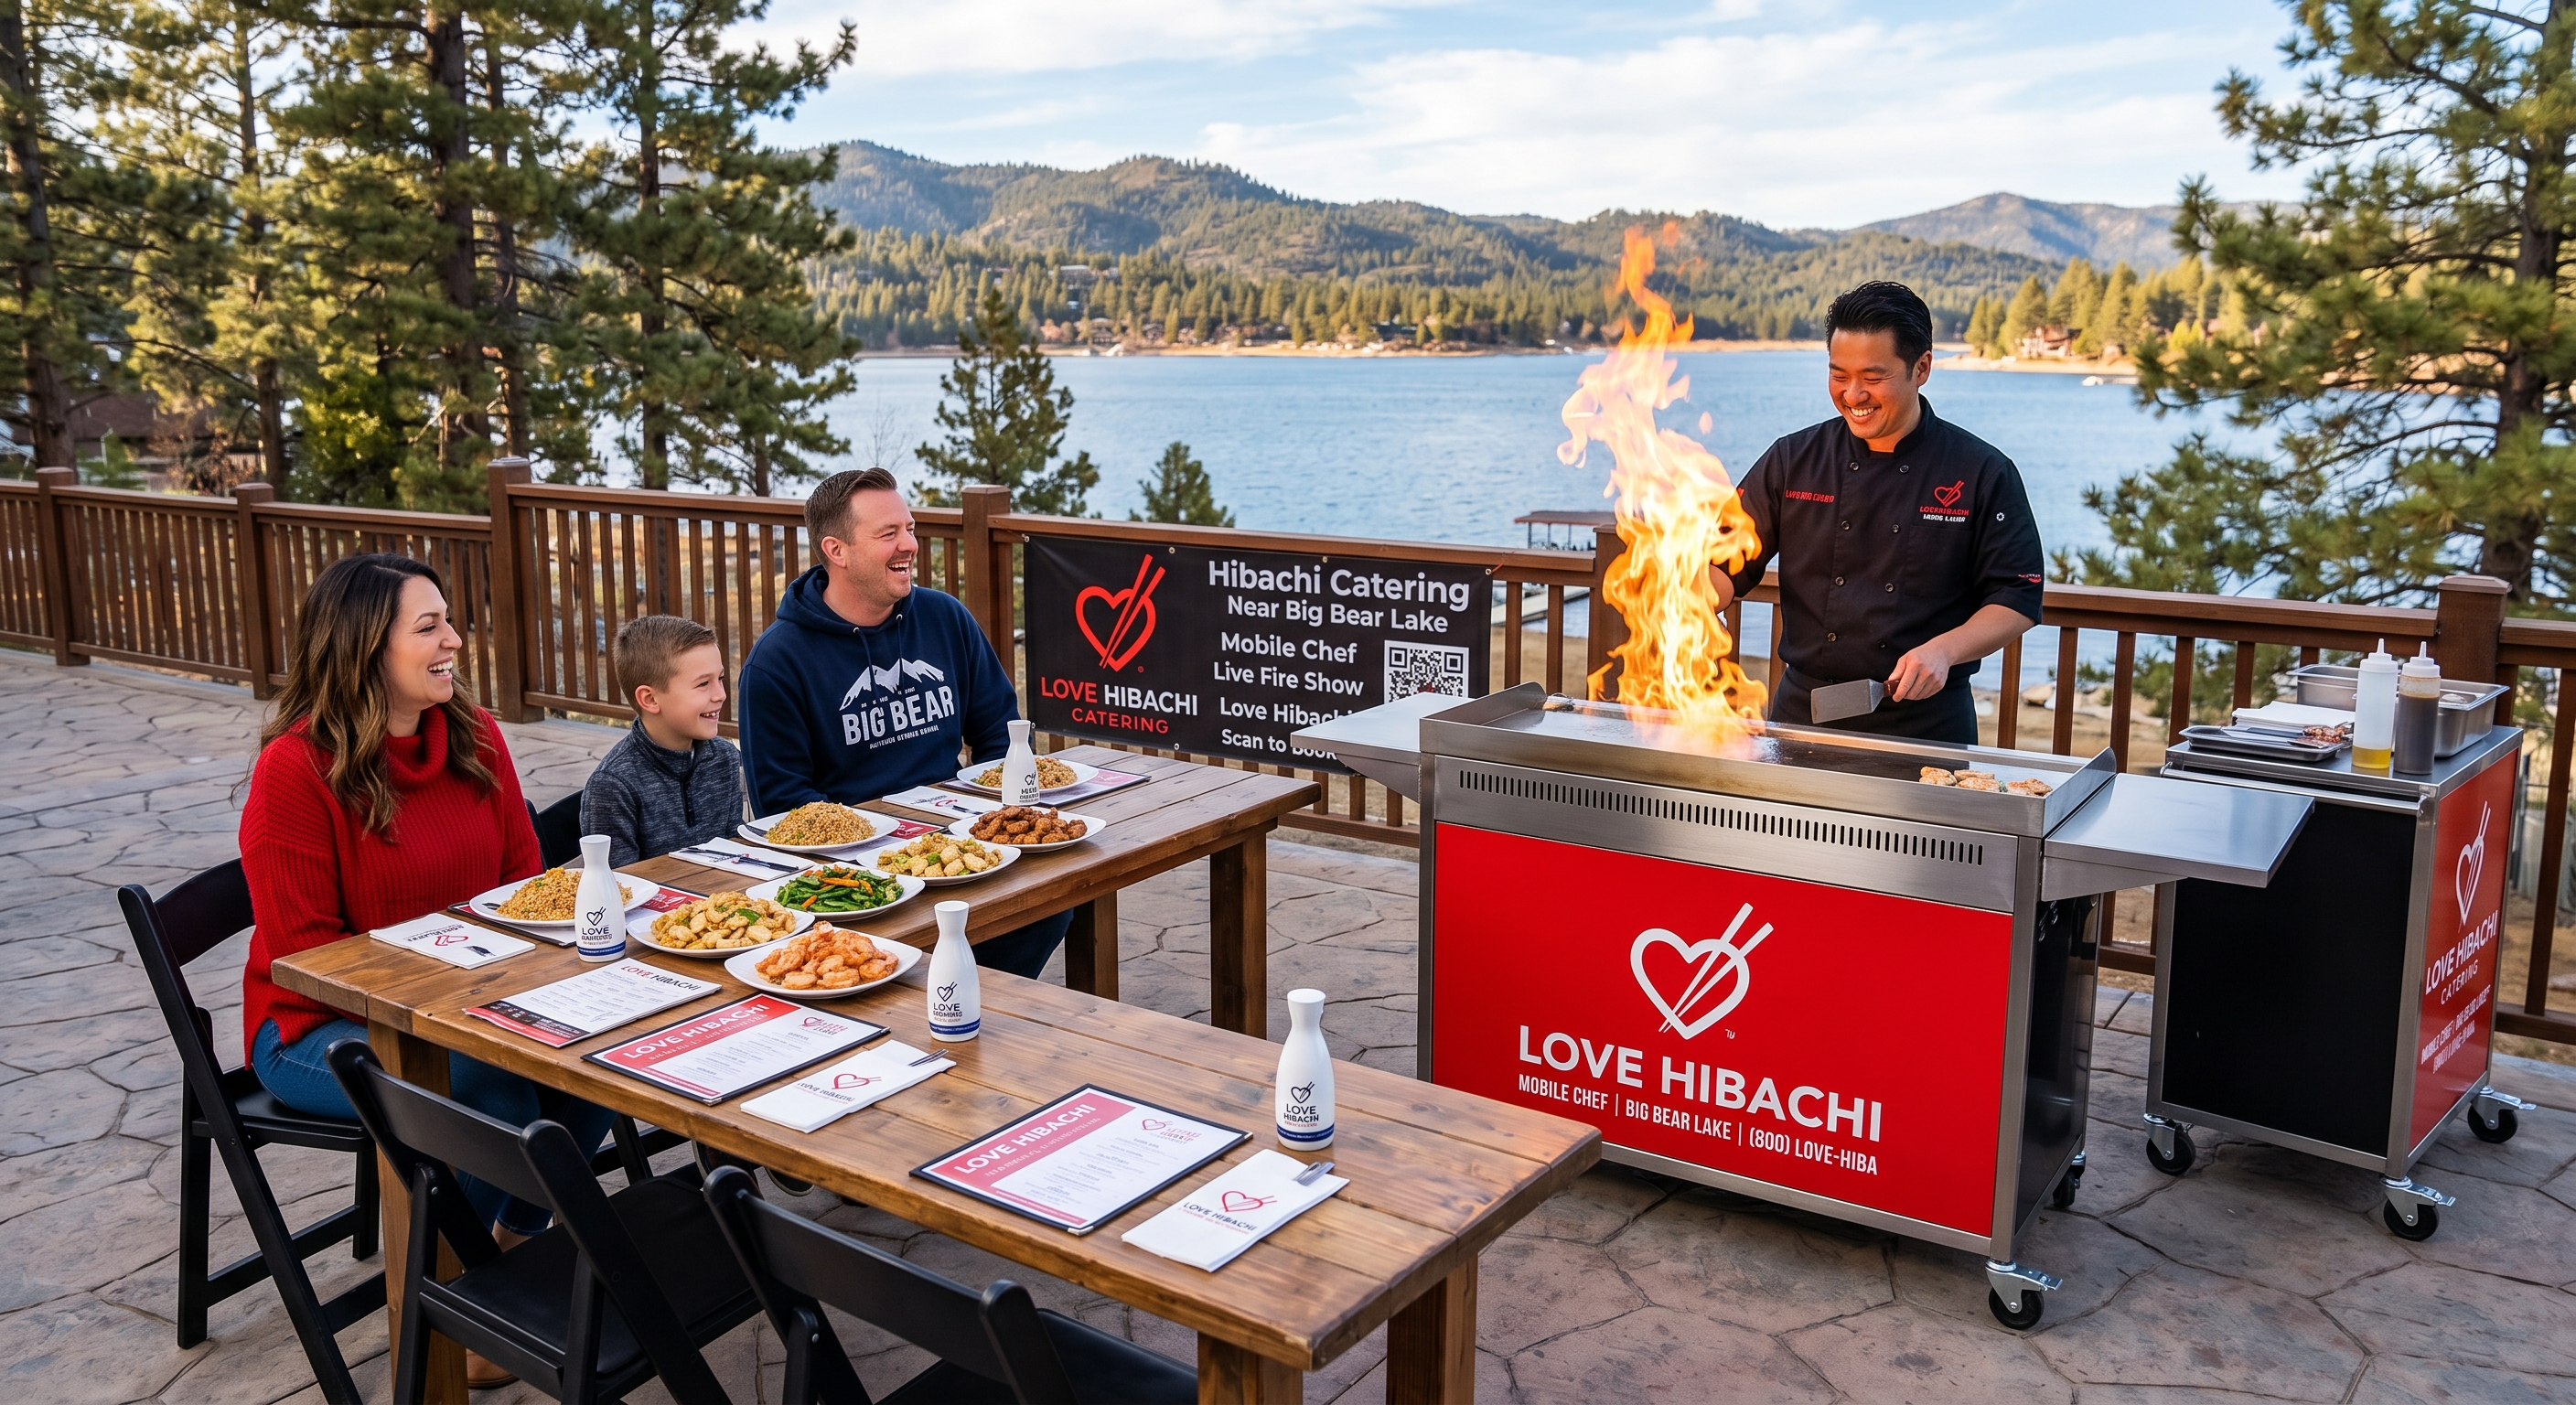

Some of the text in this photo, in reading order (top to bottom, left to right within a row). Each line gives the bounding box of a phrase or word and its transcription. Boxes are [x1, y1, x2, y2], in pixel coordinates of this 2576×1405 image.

[1208, 560, 1470, 612] Hibachi Catering
[1227, 595, 1449, 633] Near Big Bear Lake
[1221, 631, 1358, 664] Mobile Chef
[1041, 676, 1198, 716] LOVE HIBACHI
[1213, 661, 1364, 697] Live Fire Show
[842, 707, 886, 745] BIG
[889, 685, 955, 732] BEAR
[1071, 707, 1169, 735] CATERING
[1220, 696, 1353, 726] Love Hibac
[1221, 728, 1263, 750] Scan
[1268, 735, 1287, 753] to
[582, 927, 610, 936] LOVE
[2425, 909, 2498, 996] LOVE HIBACHI
[2441, 959, 2479, 1005] CATERING
[933, 1003, 961, 1012] LOVE
[623, 1035, 682, 1060] LOVE
[681, 1003, 770, 1038] HIBACHI
[1519, 1024, 1883, 1142] LOVE HIBACHI
[1286, 1103, 1316, 1115] LOVE
[1519, 1074, 1878, 1176] MOBILE CHEF BIG BEAR LAKE (800) LOVE-HIBA
[953, 1144, 1016, 1174] LOVE
[1018, 1103, 1097, 1147] HIBACHI
